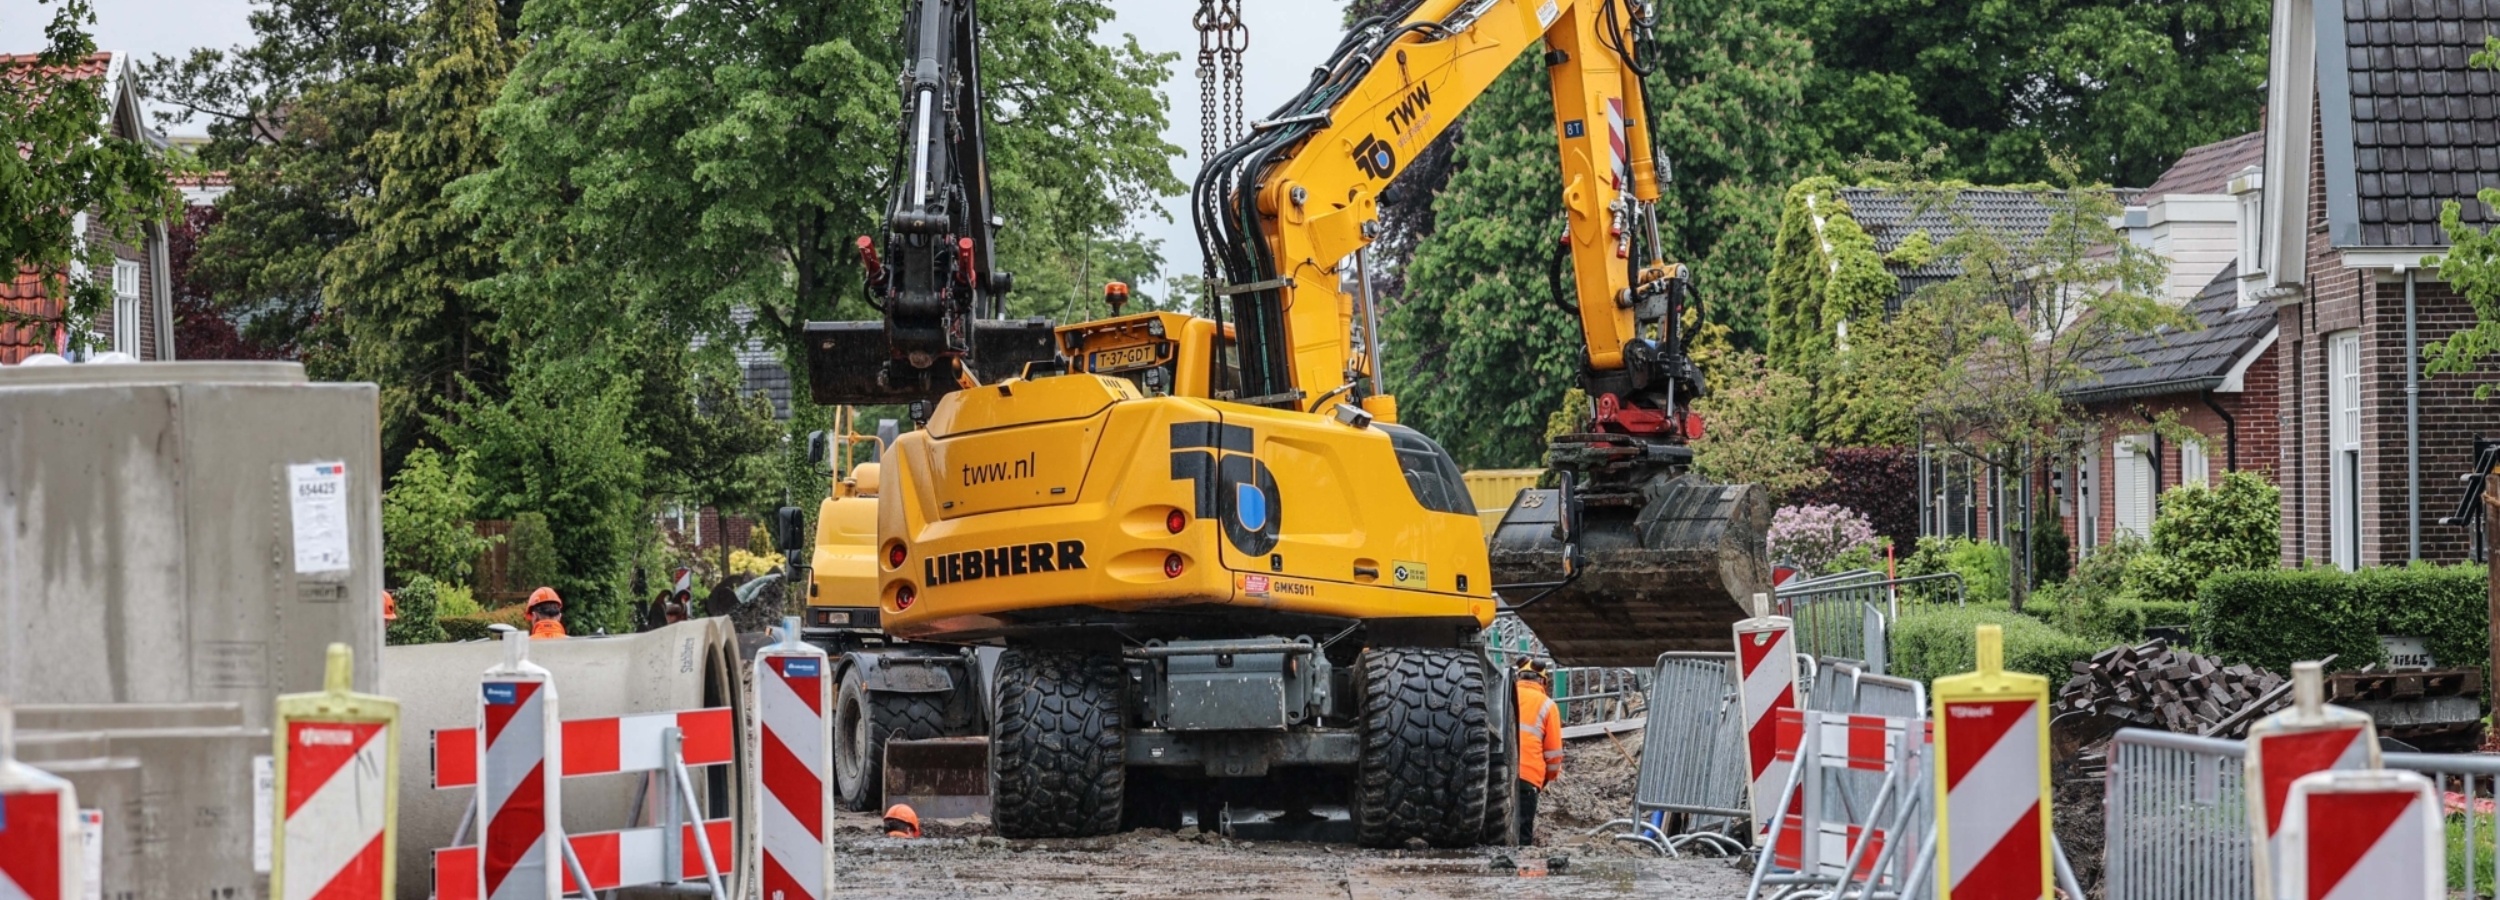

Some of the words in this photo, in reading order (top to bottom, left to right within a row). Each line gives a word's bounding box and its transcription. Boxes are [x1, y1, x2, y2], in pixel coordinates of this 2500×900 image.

[1386, 79, 1431, 135] TWW
[1100, 346, 1151, 367] T-37-GDT
[962, 451, 1035, 487] tww.nl
[925, 540, 1089, 588] LIEBHERR
[1274, 581, 1315, 596] GMK5011
